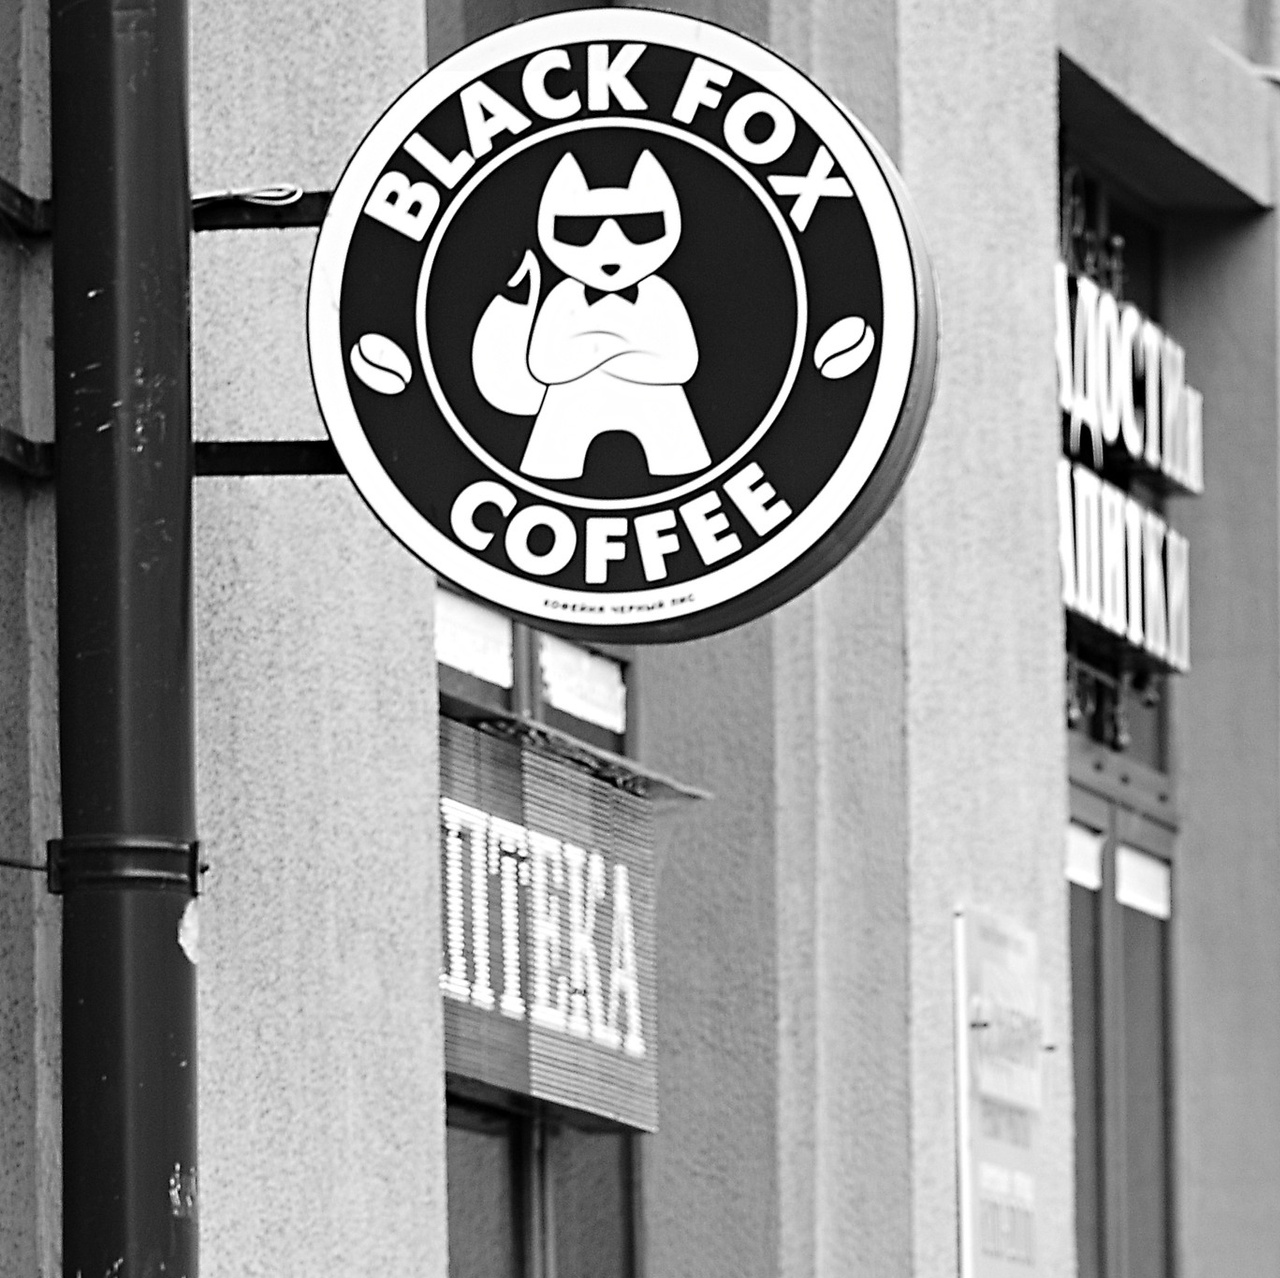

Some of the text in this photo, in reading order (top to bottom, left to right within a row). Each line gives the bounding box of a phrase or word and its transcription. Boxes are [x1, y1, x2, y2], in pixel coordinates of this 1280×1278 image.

[363, 43, 854, 242] BLACK FOX
[450, 461, 794, 584] COFFEE
[440, 797, 646, 1057] ПТЕКА
